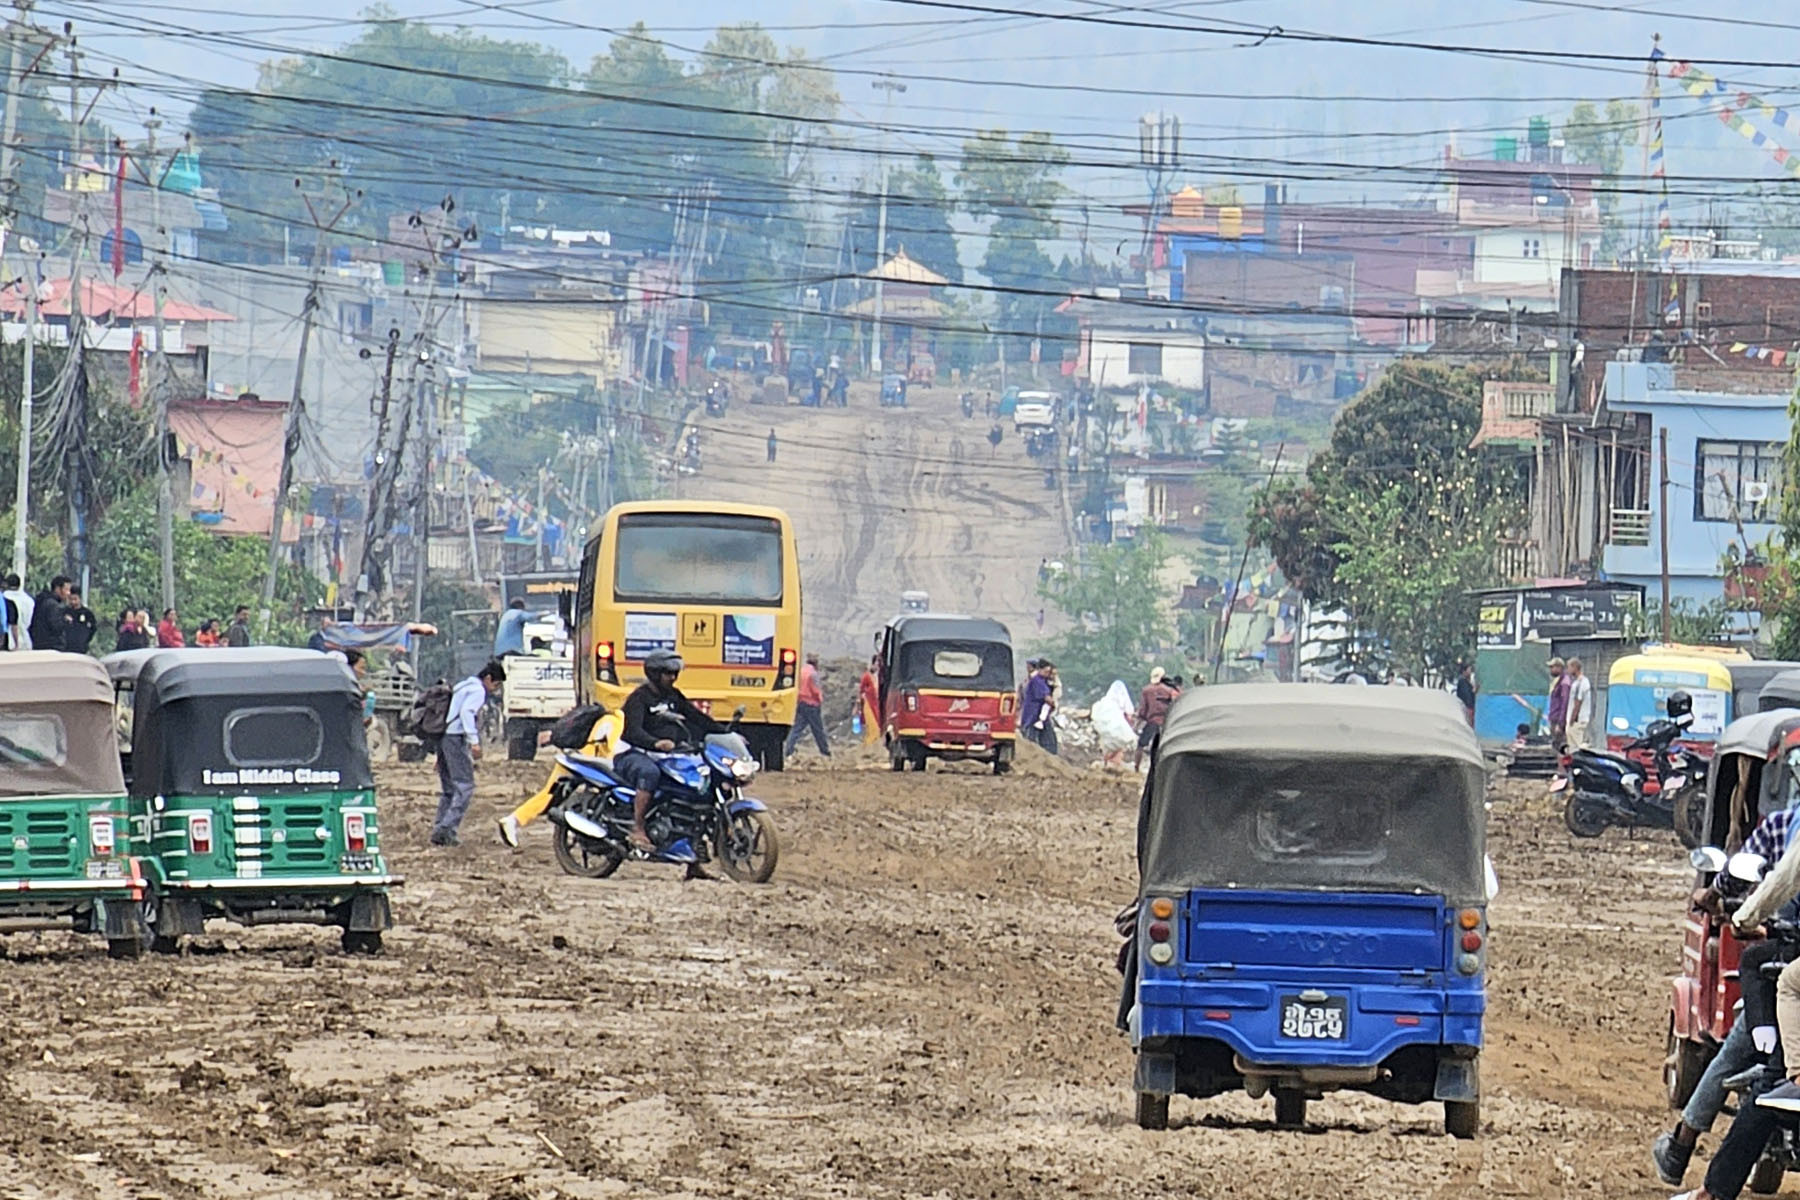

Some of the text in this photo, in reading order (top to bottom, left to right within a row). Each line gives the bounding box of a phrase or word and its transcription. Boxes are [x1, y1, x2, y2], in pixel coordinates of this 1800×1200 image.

[732, 675, 765, 688] TATA
[203, 768, 341, 784] I am Middle Class
